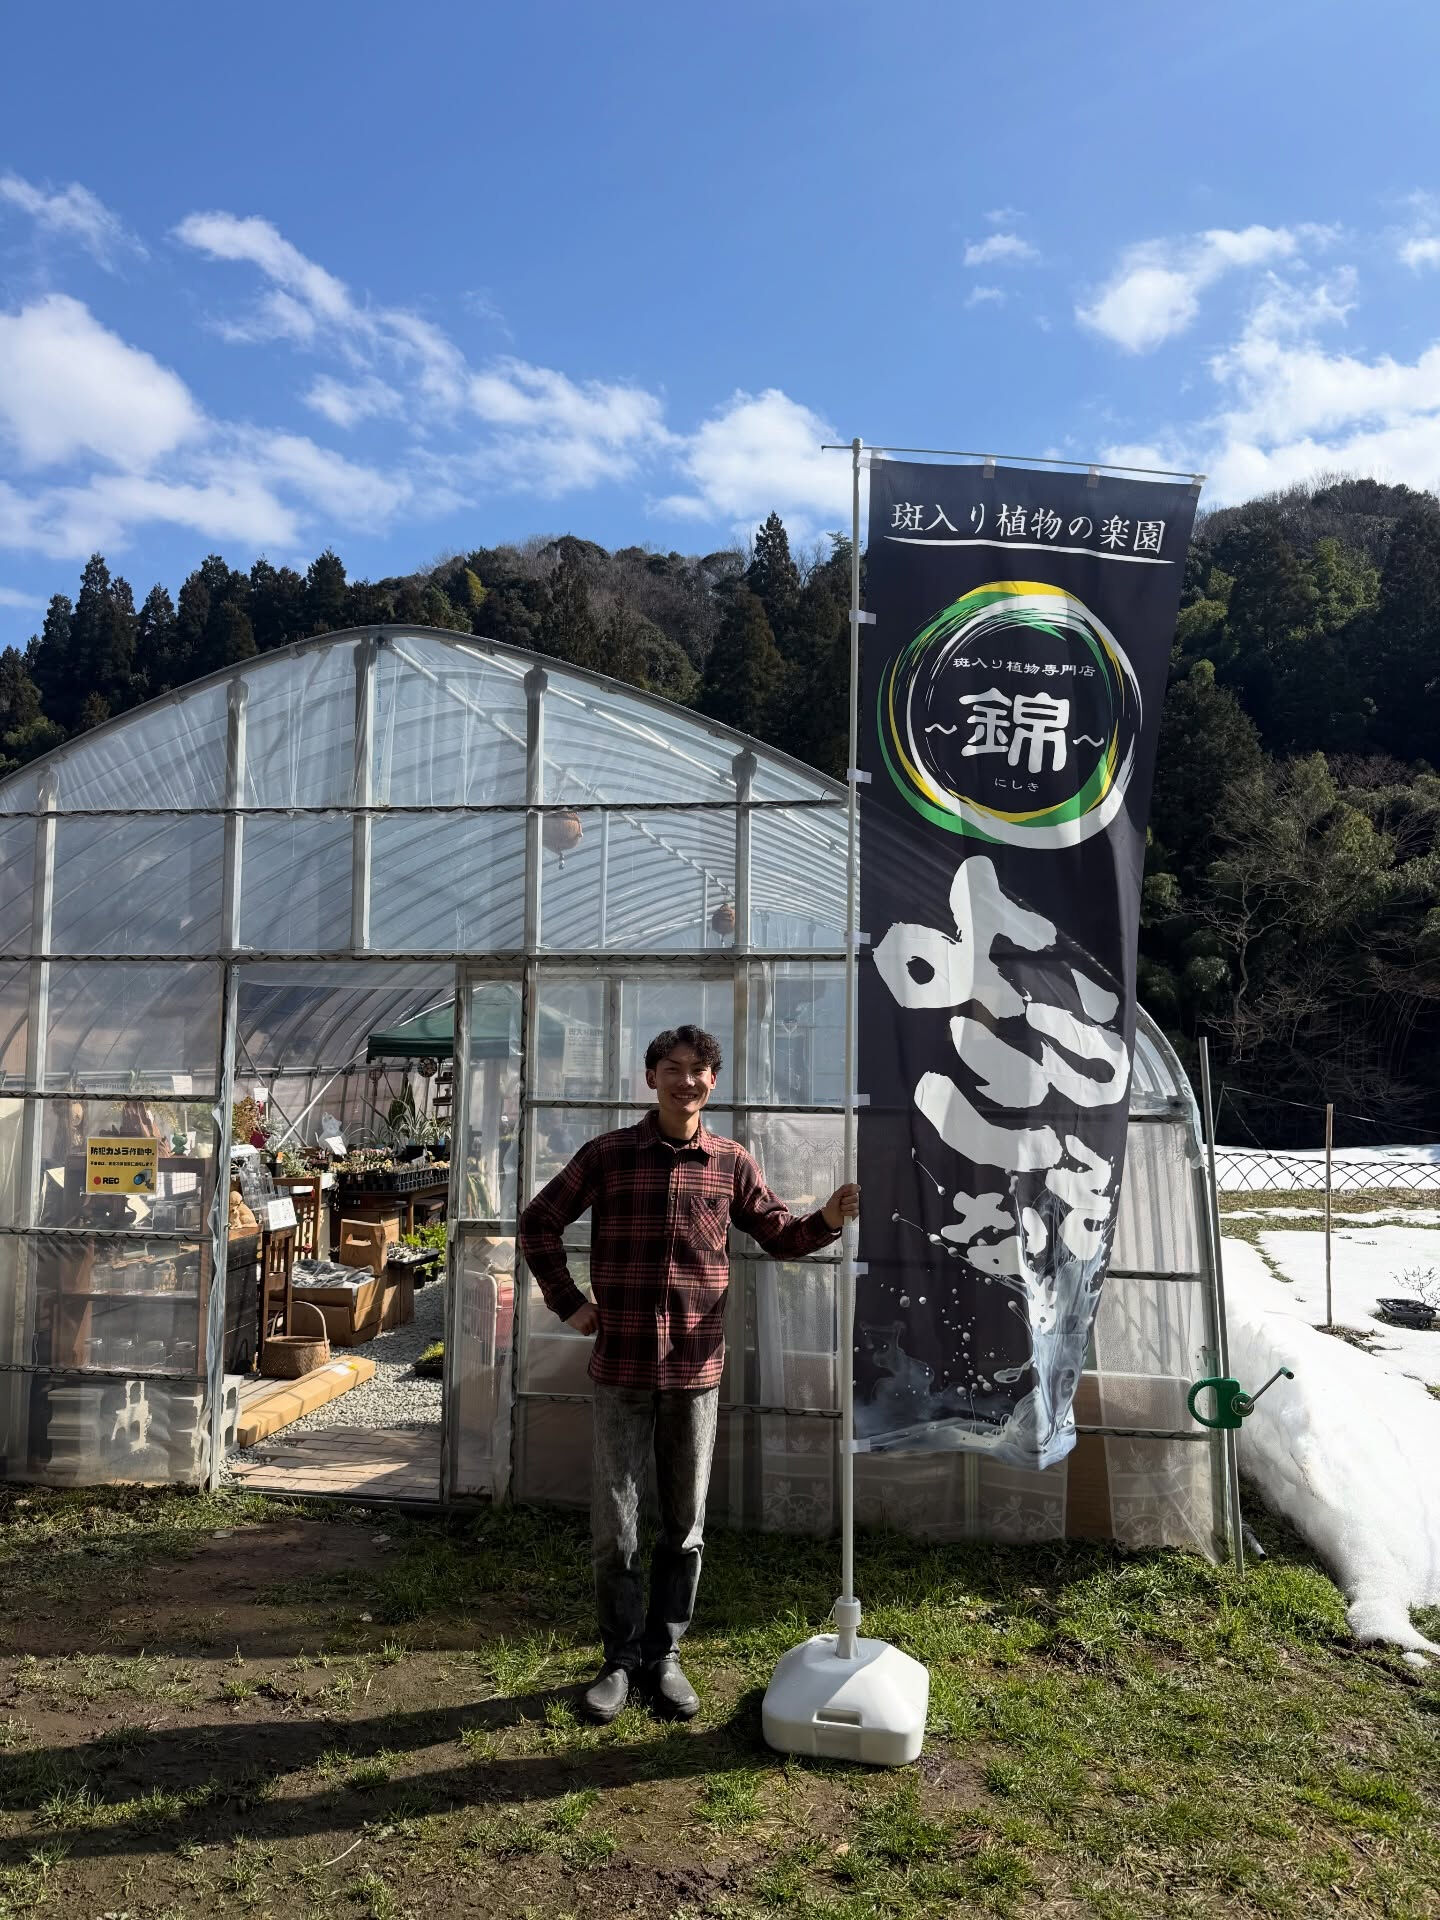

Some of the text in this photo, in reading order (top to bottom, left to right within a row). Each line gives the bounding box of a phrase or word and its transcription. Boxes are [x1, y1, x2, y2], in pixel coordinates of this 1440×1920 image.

[890, 502, 1166, 555] 斑入り植物の楽園
[952, 656, 1097, 679] 斑入り植物専門店
[993, 776, 1040, 793] にしき
[102, 1177, 120, 1185] REC
